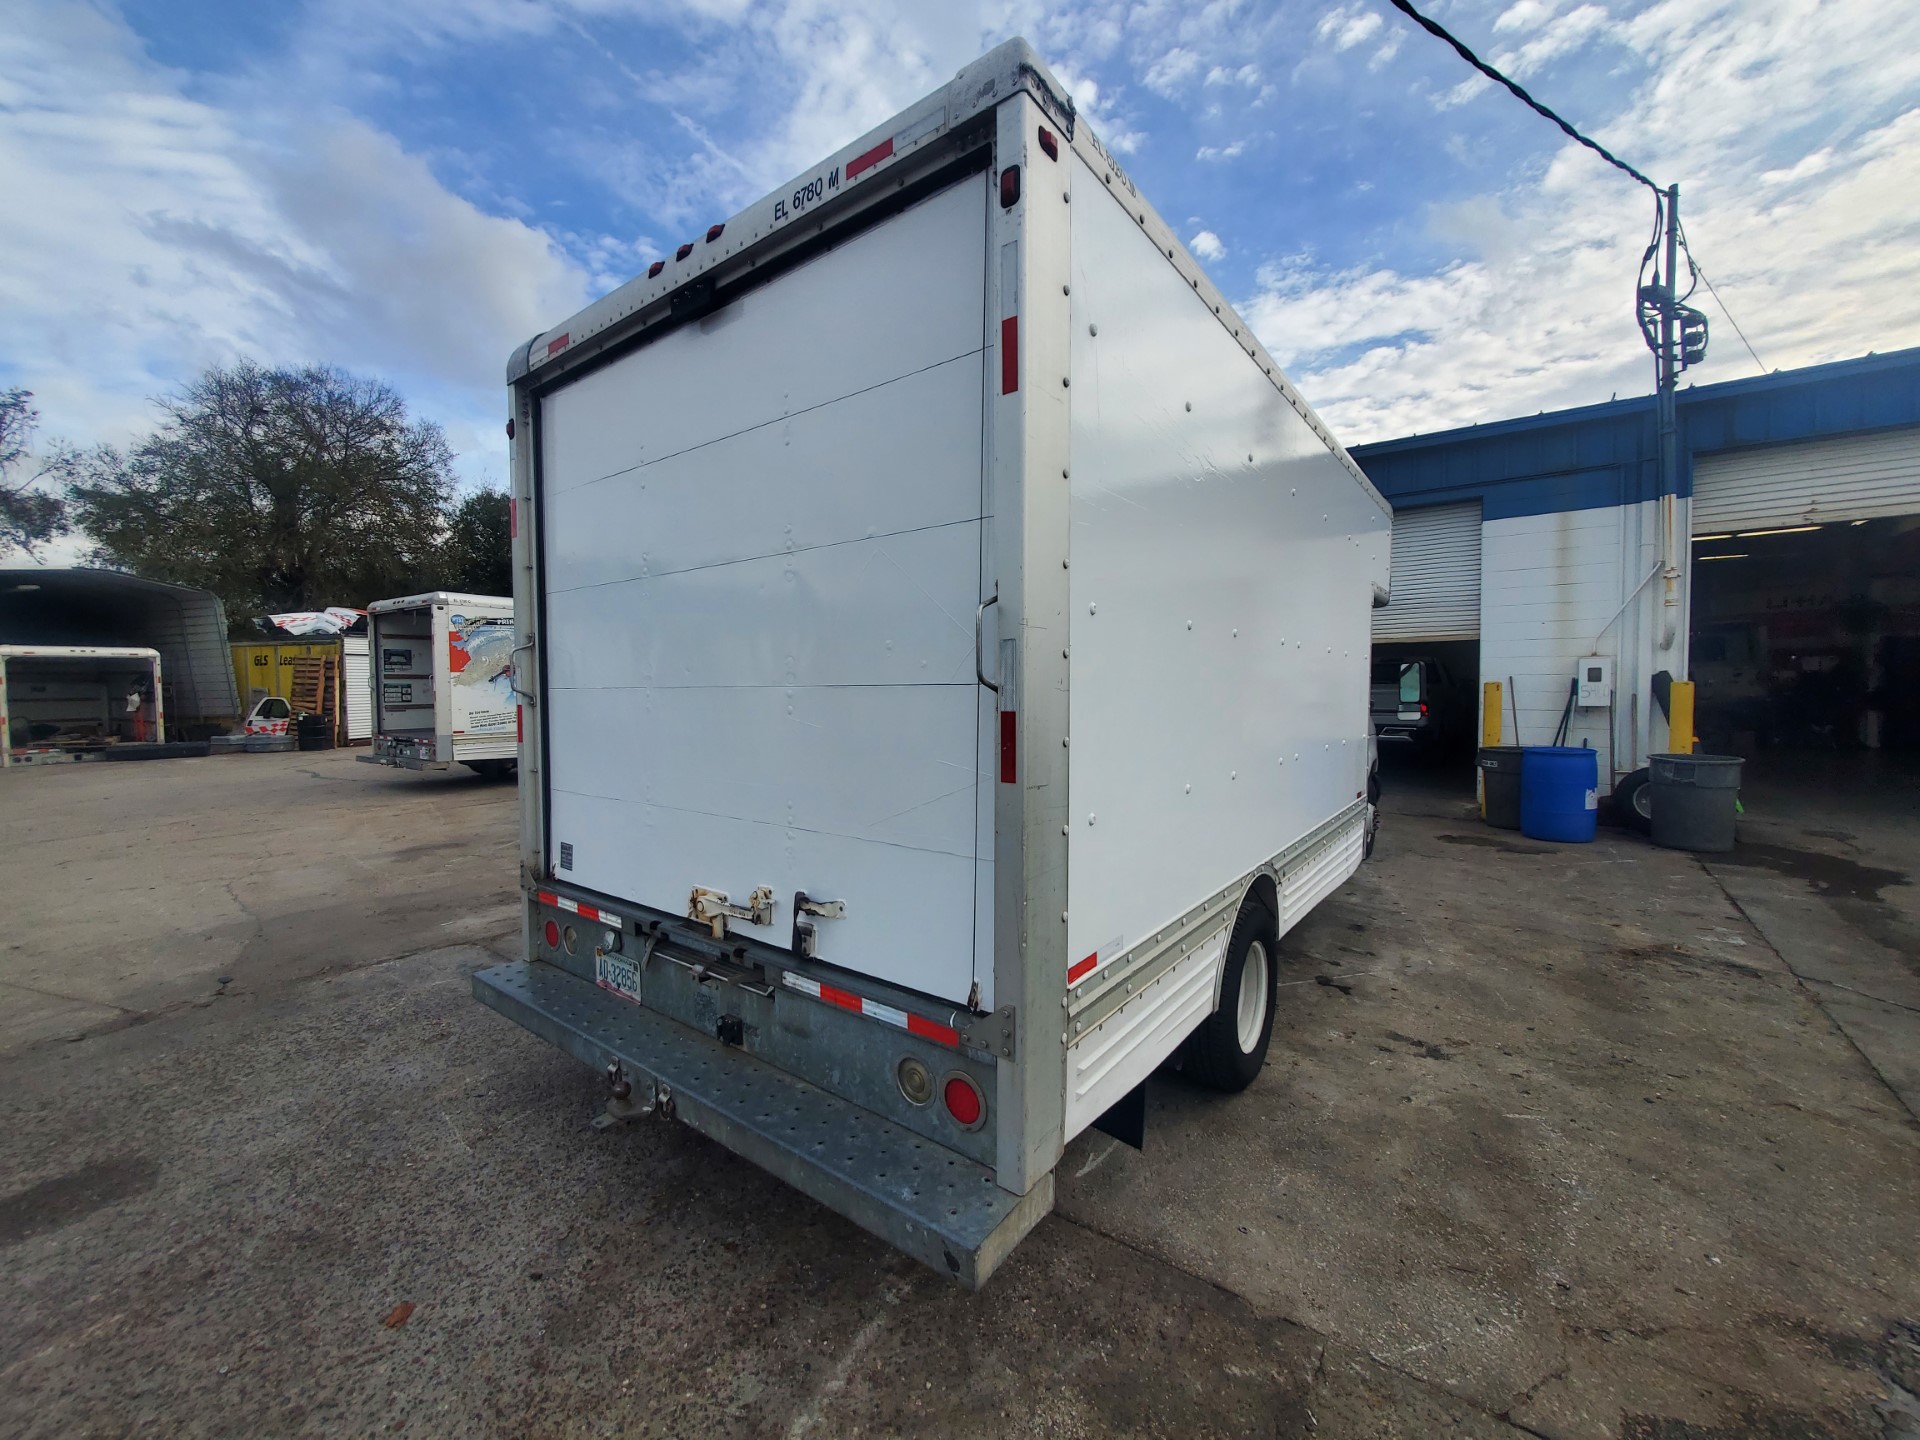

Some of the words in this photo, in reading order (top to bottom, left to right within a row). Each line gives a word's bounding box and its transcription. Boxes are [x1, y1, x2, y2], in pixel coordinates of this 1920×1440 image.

[775, 199, 788, 222] EL
[793, 177, 823, 210] 6780
[828, 167, 840, 190] M
[254, 654, 269, 667] GLS
